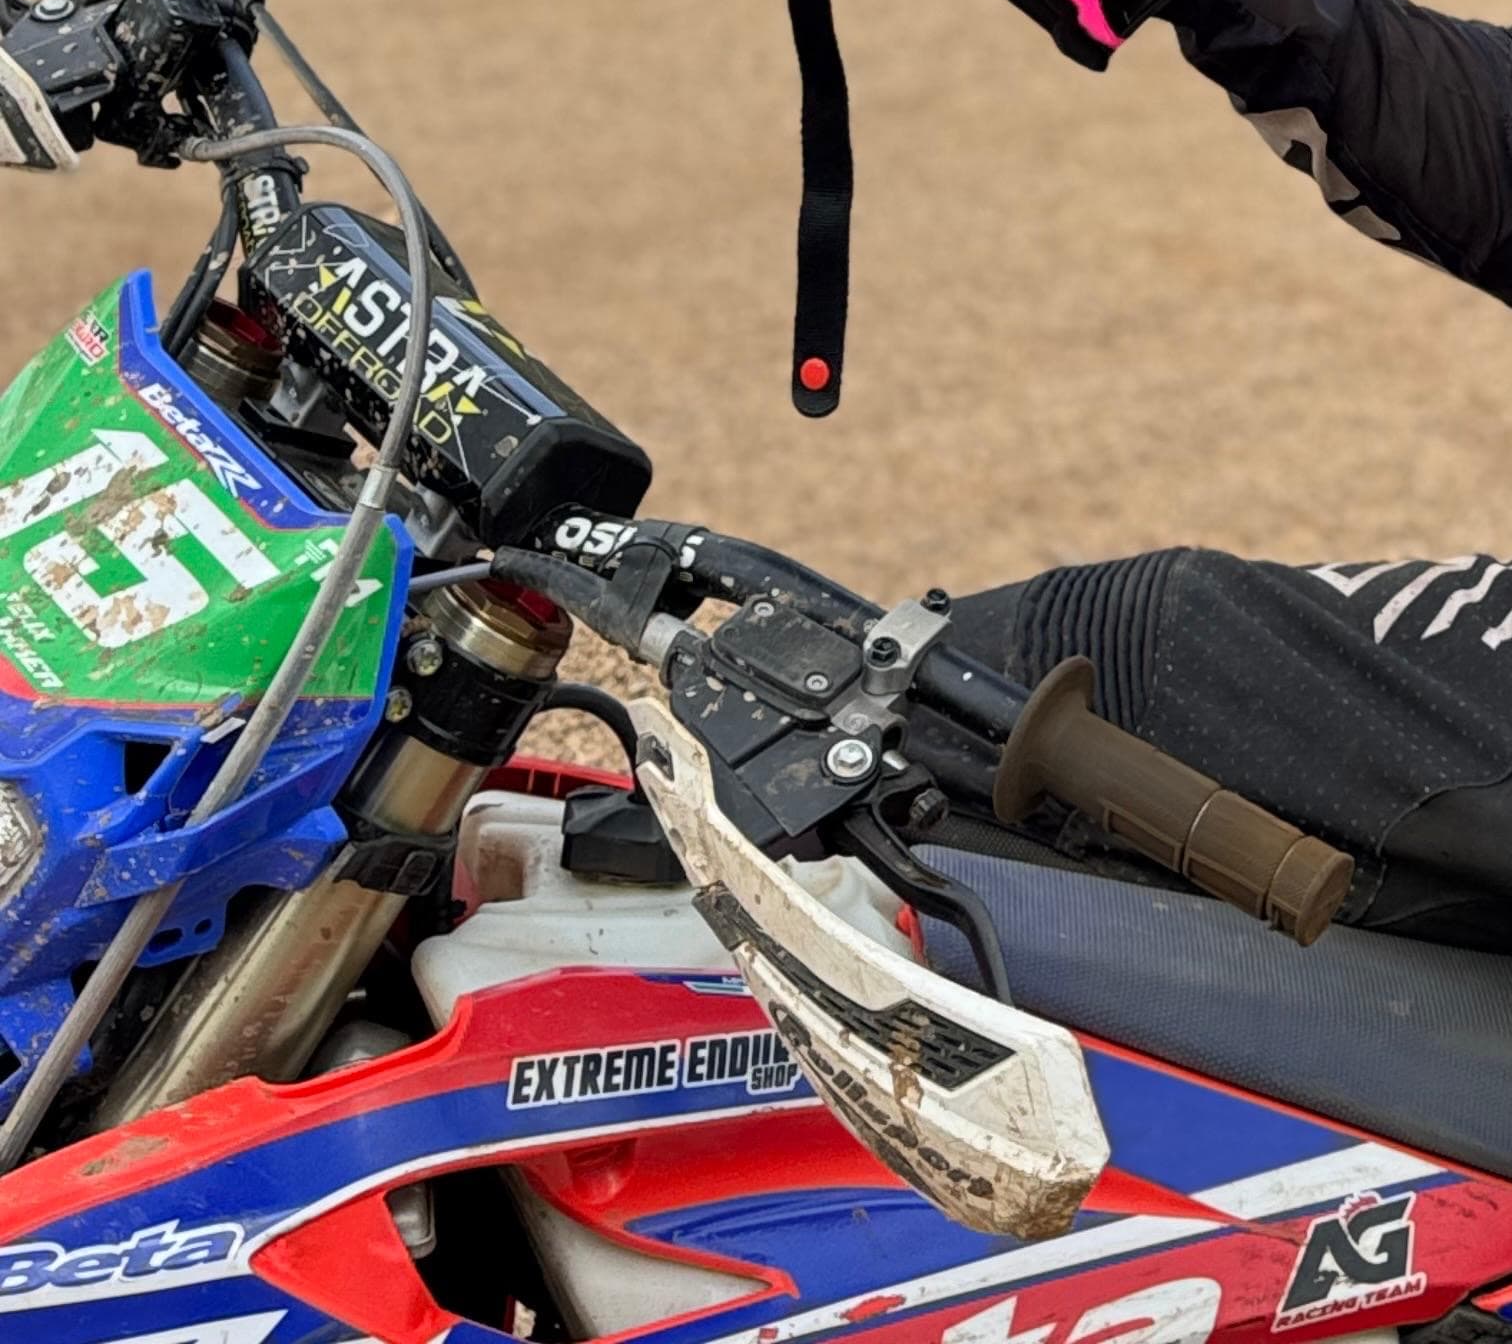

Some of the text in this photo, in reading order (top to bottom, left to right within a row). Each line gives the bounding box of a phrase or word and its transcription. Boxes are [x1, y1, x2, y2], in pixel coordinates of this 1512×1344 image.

[293, 291, 453, 444] OFFROD
[512, 1043, 679, 1105] EXTREME
[752, 1063, 798, 1090] SHOP
[0, 1230, 240, 1296] Beta
[1281, 1195, 1411, 1312] AG
[1276, 1278, 1422, 1329] RACING TEAM
